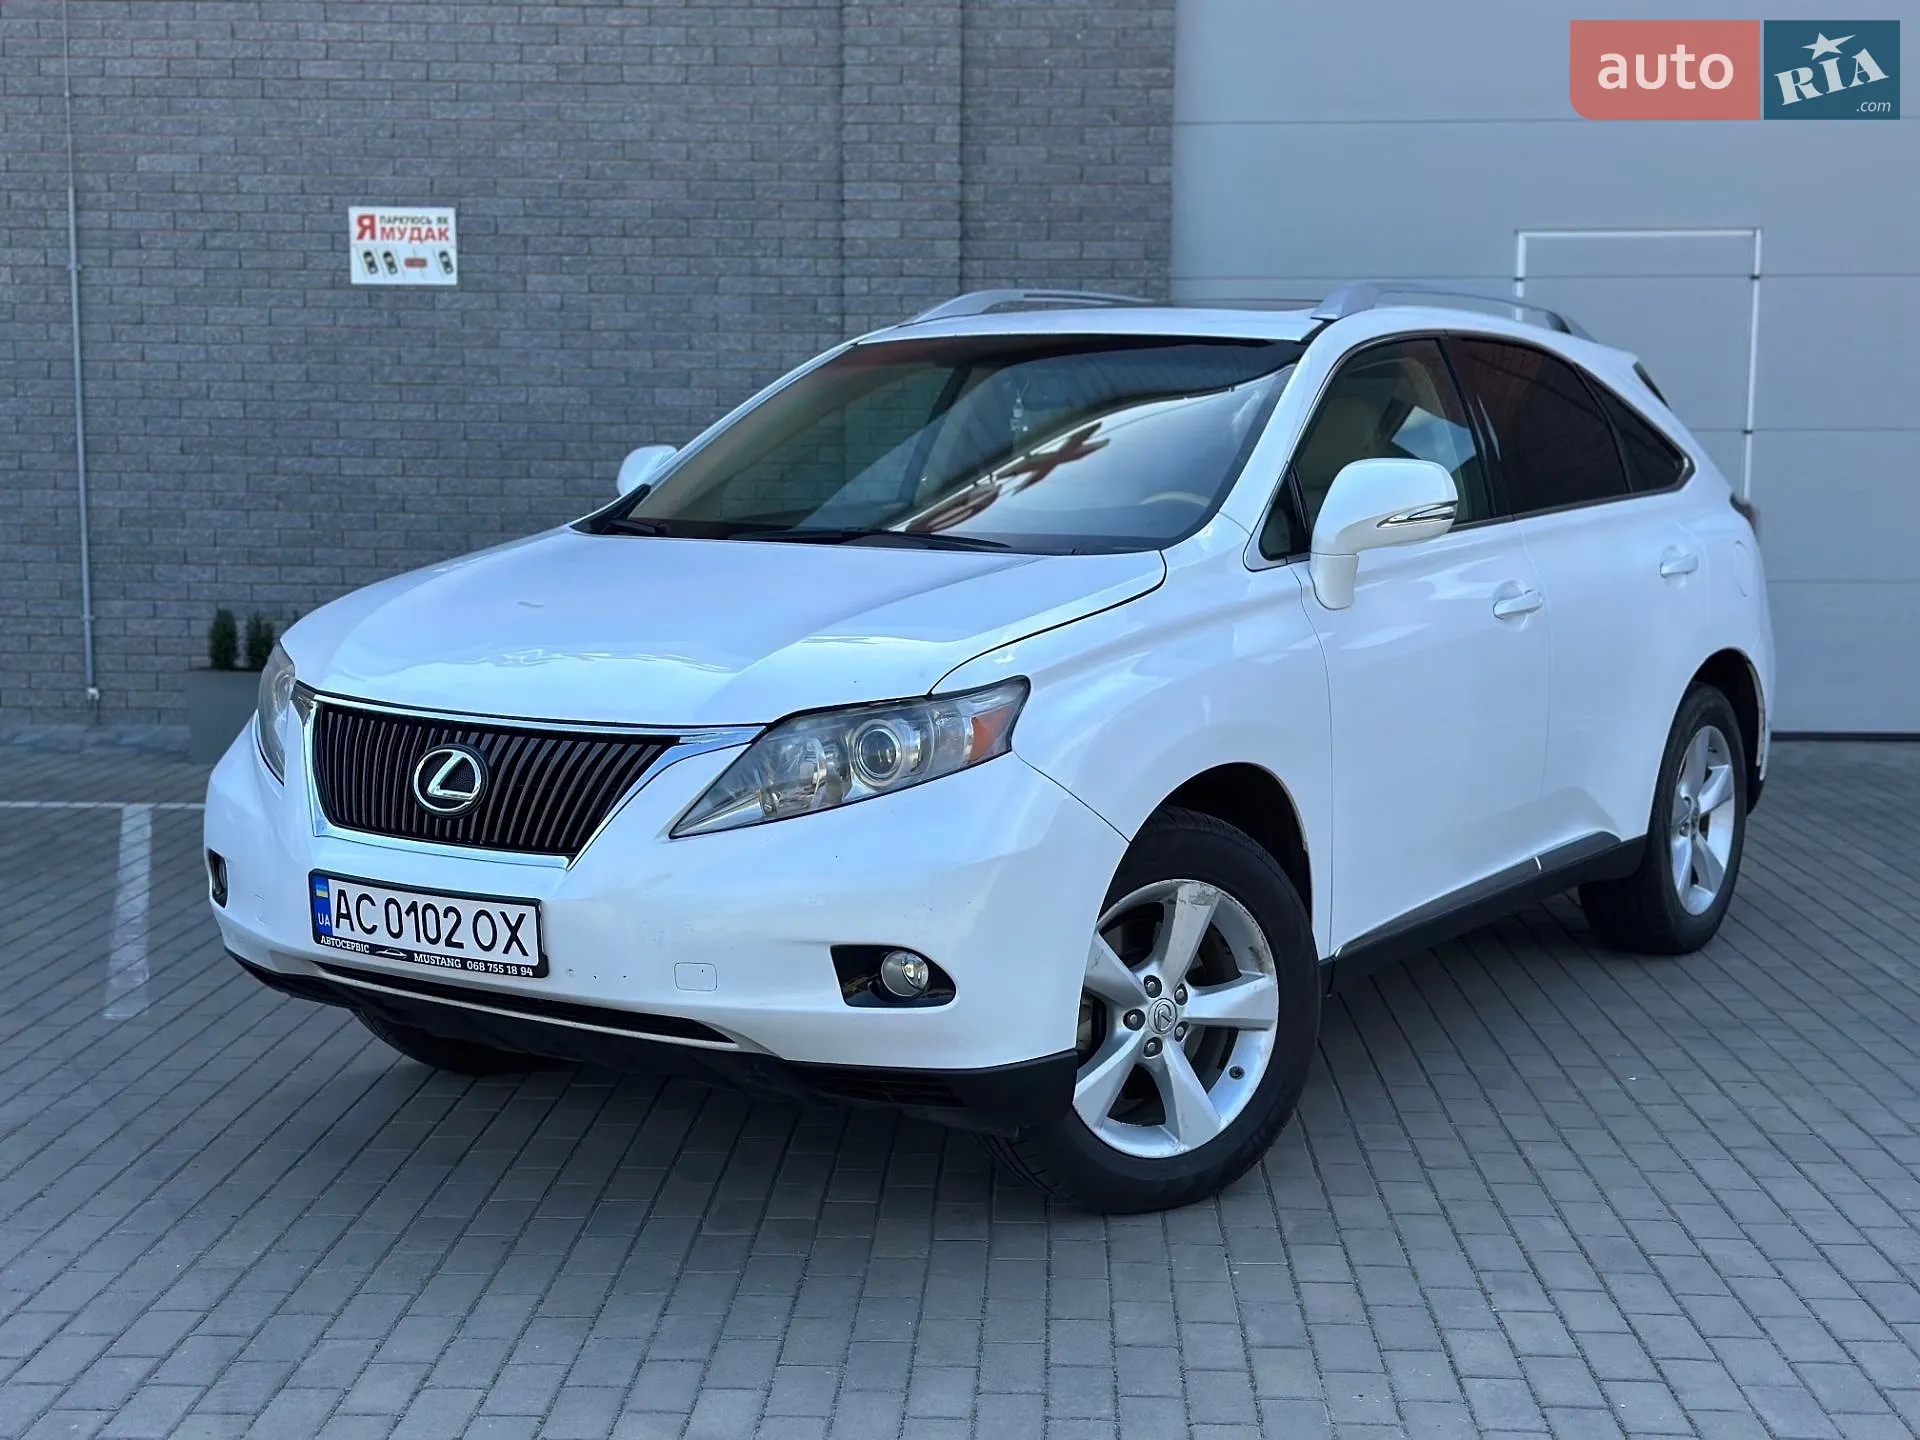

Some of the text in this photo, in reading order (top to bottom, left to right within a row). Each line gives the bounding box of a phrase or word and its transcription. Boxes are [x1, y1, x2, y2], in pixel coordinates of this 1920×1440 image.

[356, 214, 377, 241] Я
[380, 215, 449, 225] ПАРКУЮСЬ ЯК
[380, 227, 450, 244] МУДАК
[317, 912, 332, 927] UA
[335, 889, 529, 957] AC 0102 OX
[320, 935, 370, 953] АВТОСЕРВІС
[413, 952, 533, 976] MUSTANG 068 755 18 94
